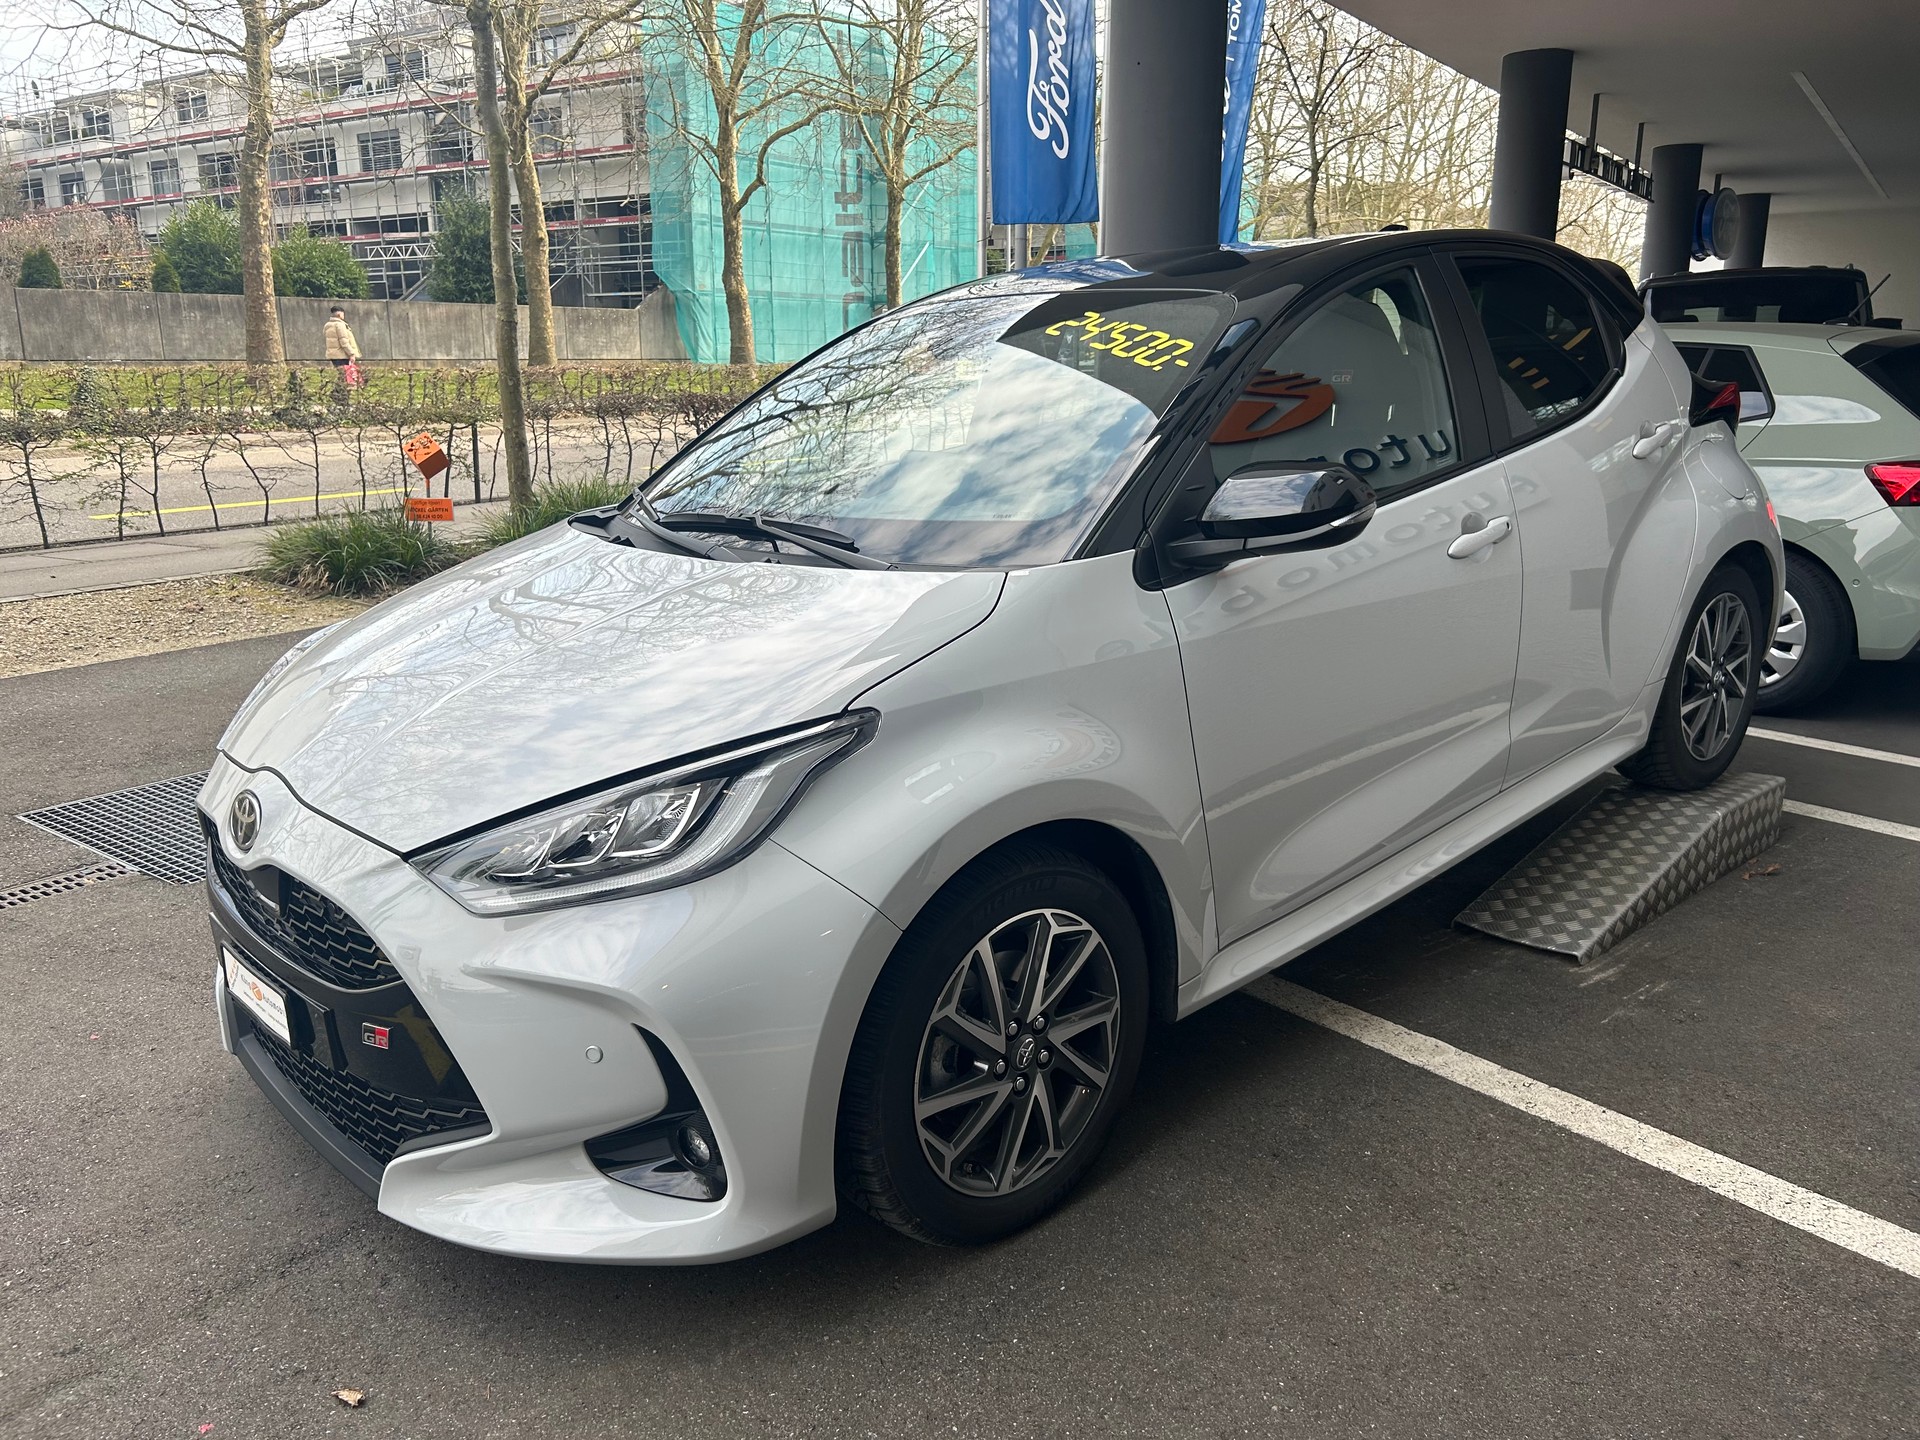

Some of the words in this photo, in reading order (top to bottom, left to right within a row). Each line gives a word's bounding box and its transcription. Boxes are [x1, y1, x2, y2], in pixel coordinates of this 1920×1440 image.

[1027, 0, 1070, 160] Ford
[1332, 373, 1351, 383] GR
[364, 1032, 388, 1048] GR
